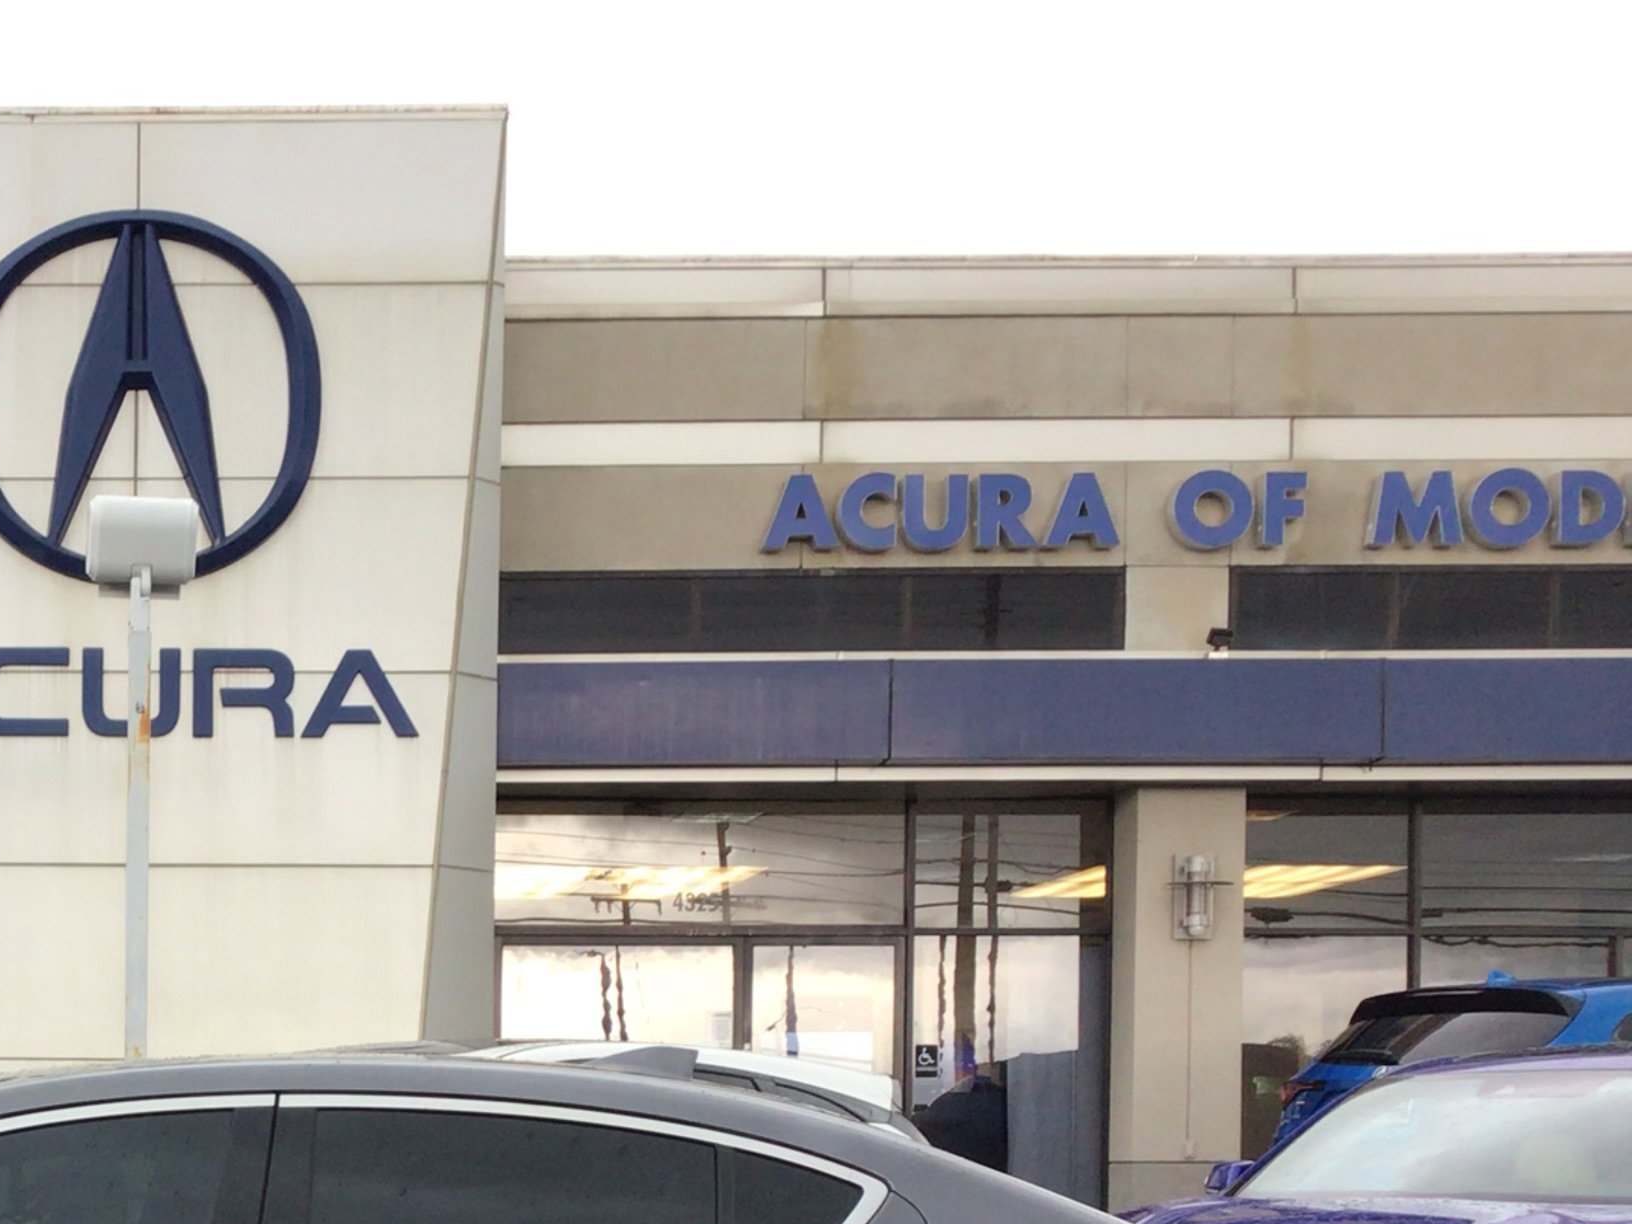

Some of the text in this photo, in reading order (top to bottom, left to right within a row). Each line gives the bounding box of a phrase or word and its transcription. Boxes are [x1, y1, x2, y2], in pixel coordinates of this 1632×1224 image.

[761, 466, 1632, 553] ACURA OF MOD
